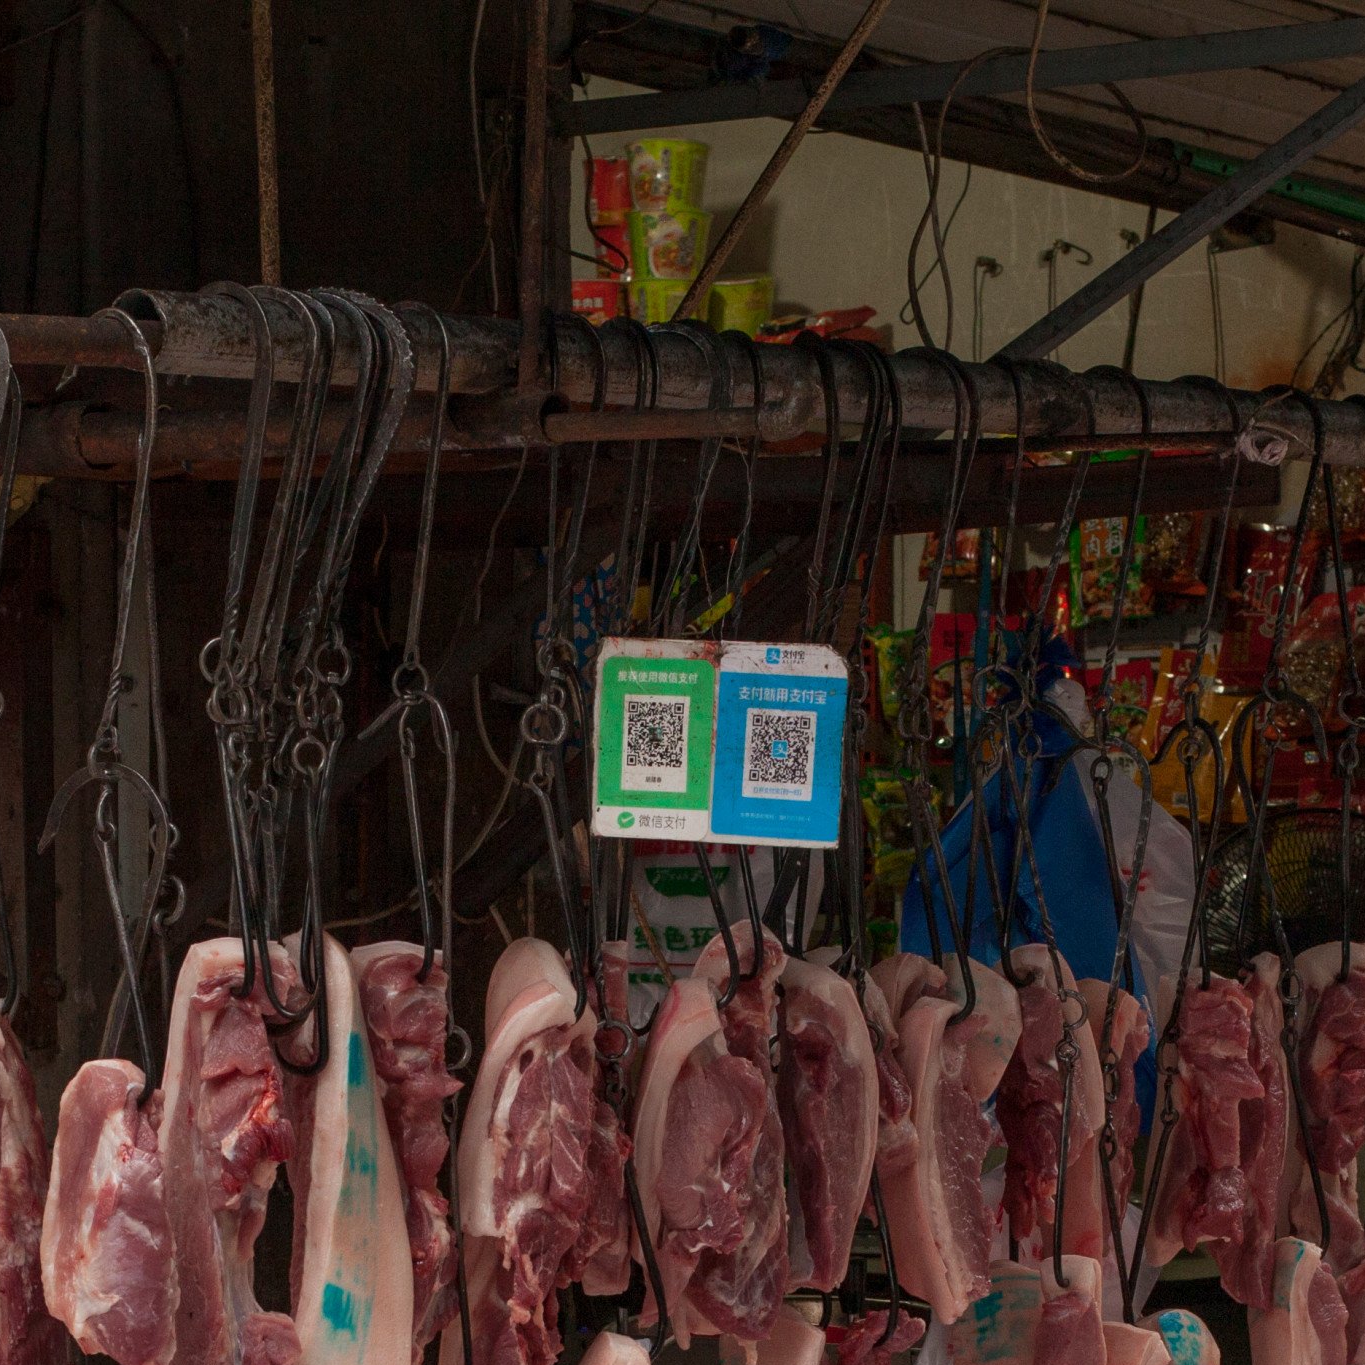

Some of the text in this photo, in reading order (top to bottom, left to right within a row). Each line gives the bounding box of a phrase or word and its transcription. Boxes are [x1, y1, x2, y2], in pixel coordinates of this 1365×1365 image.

[782, 649, 805, 661] 支付宝
[638, 815, 687, 830] 微信支付
